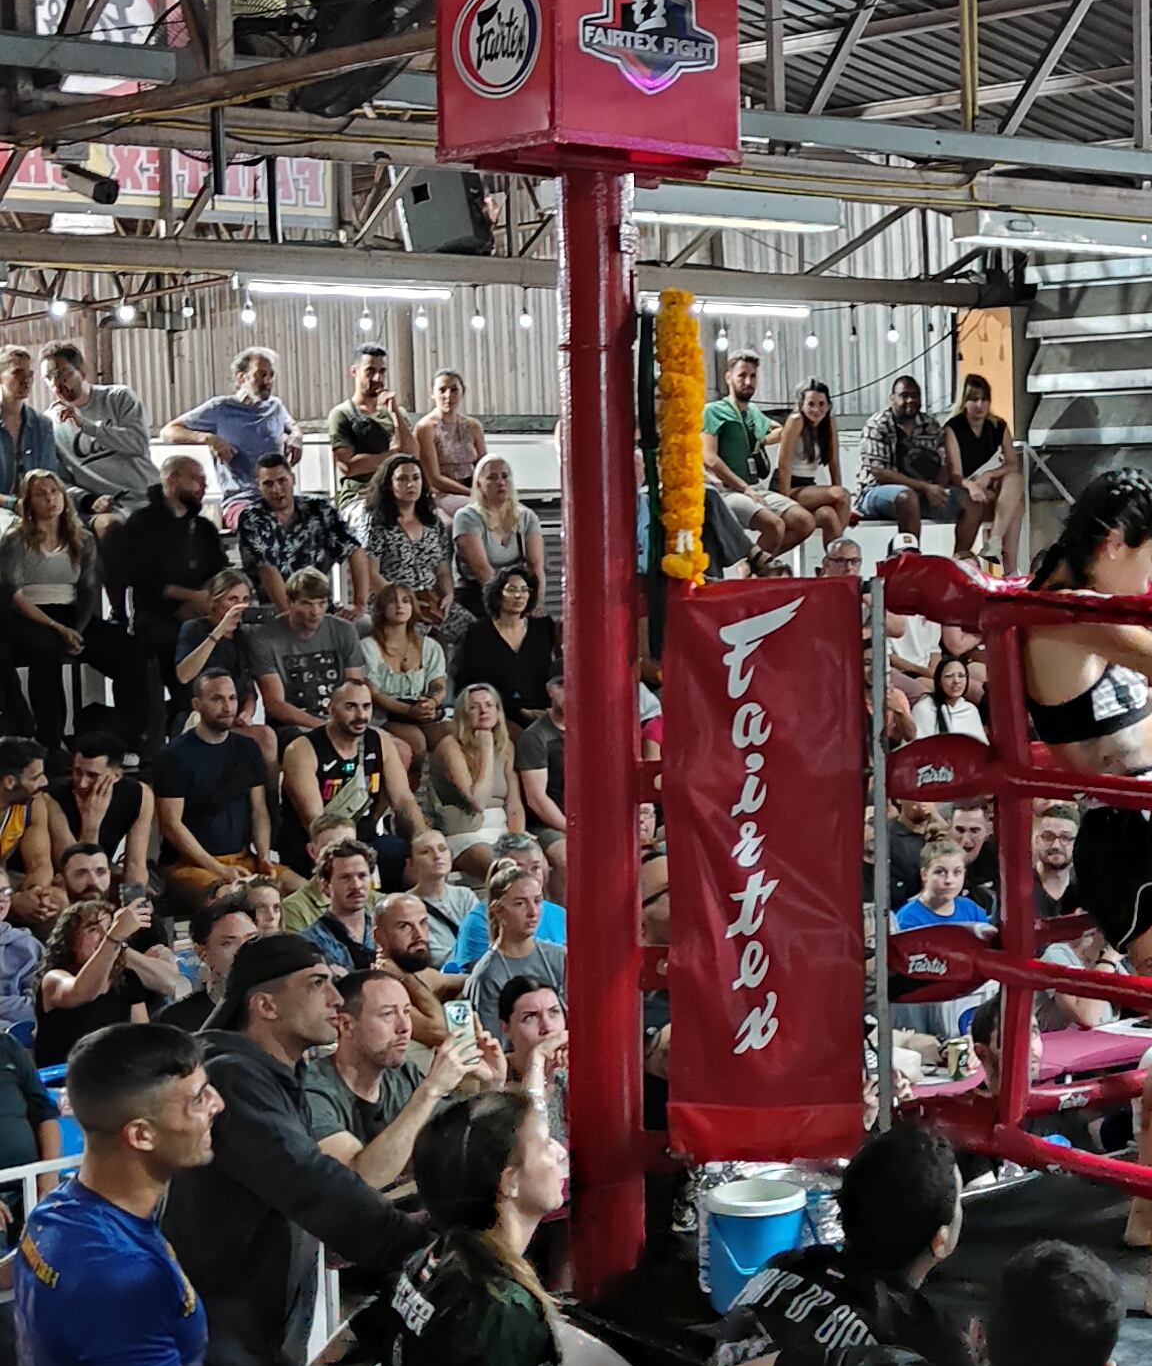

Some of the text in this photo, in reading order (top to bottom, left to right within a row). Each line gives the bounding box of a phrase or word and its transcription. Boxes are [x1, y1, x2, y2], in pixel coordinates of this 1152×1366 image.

[584, 25, 714, 60] FAIRTEX FIGHT
[719, 596, 806, 1055] Fairtex
[814, 1304, 879, 1348] SIA
